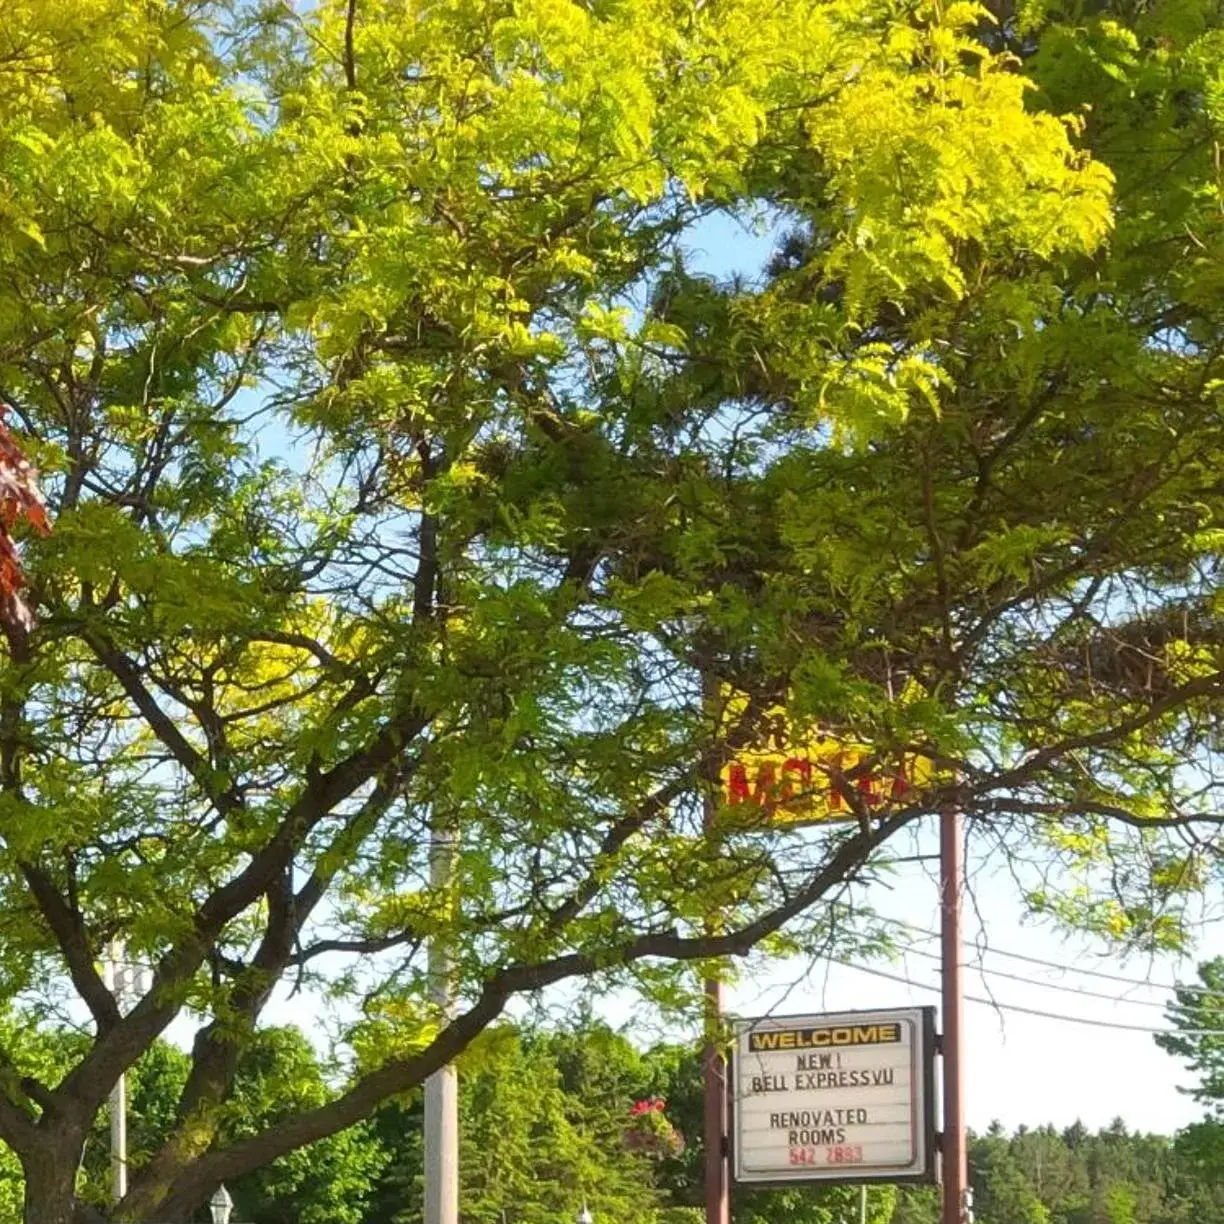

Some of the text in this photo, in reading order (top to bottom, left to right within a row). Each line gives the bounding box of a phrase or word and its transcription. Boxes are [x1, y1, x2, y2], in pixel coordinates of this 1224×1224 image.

[752, 1025, 897, 1050] WELCOME
[751, 1074, 788, 1093] BELL
[769, 1108, 868, 1129] RENOVATED
[788, 1128, 846, 1146] ROOMS
